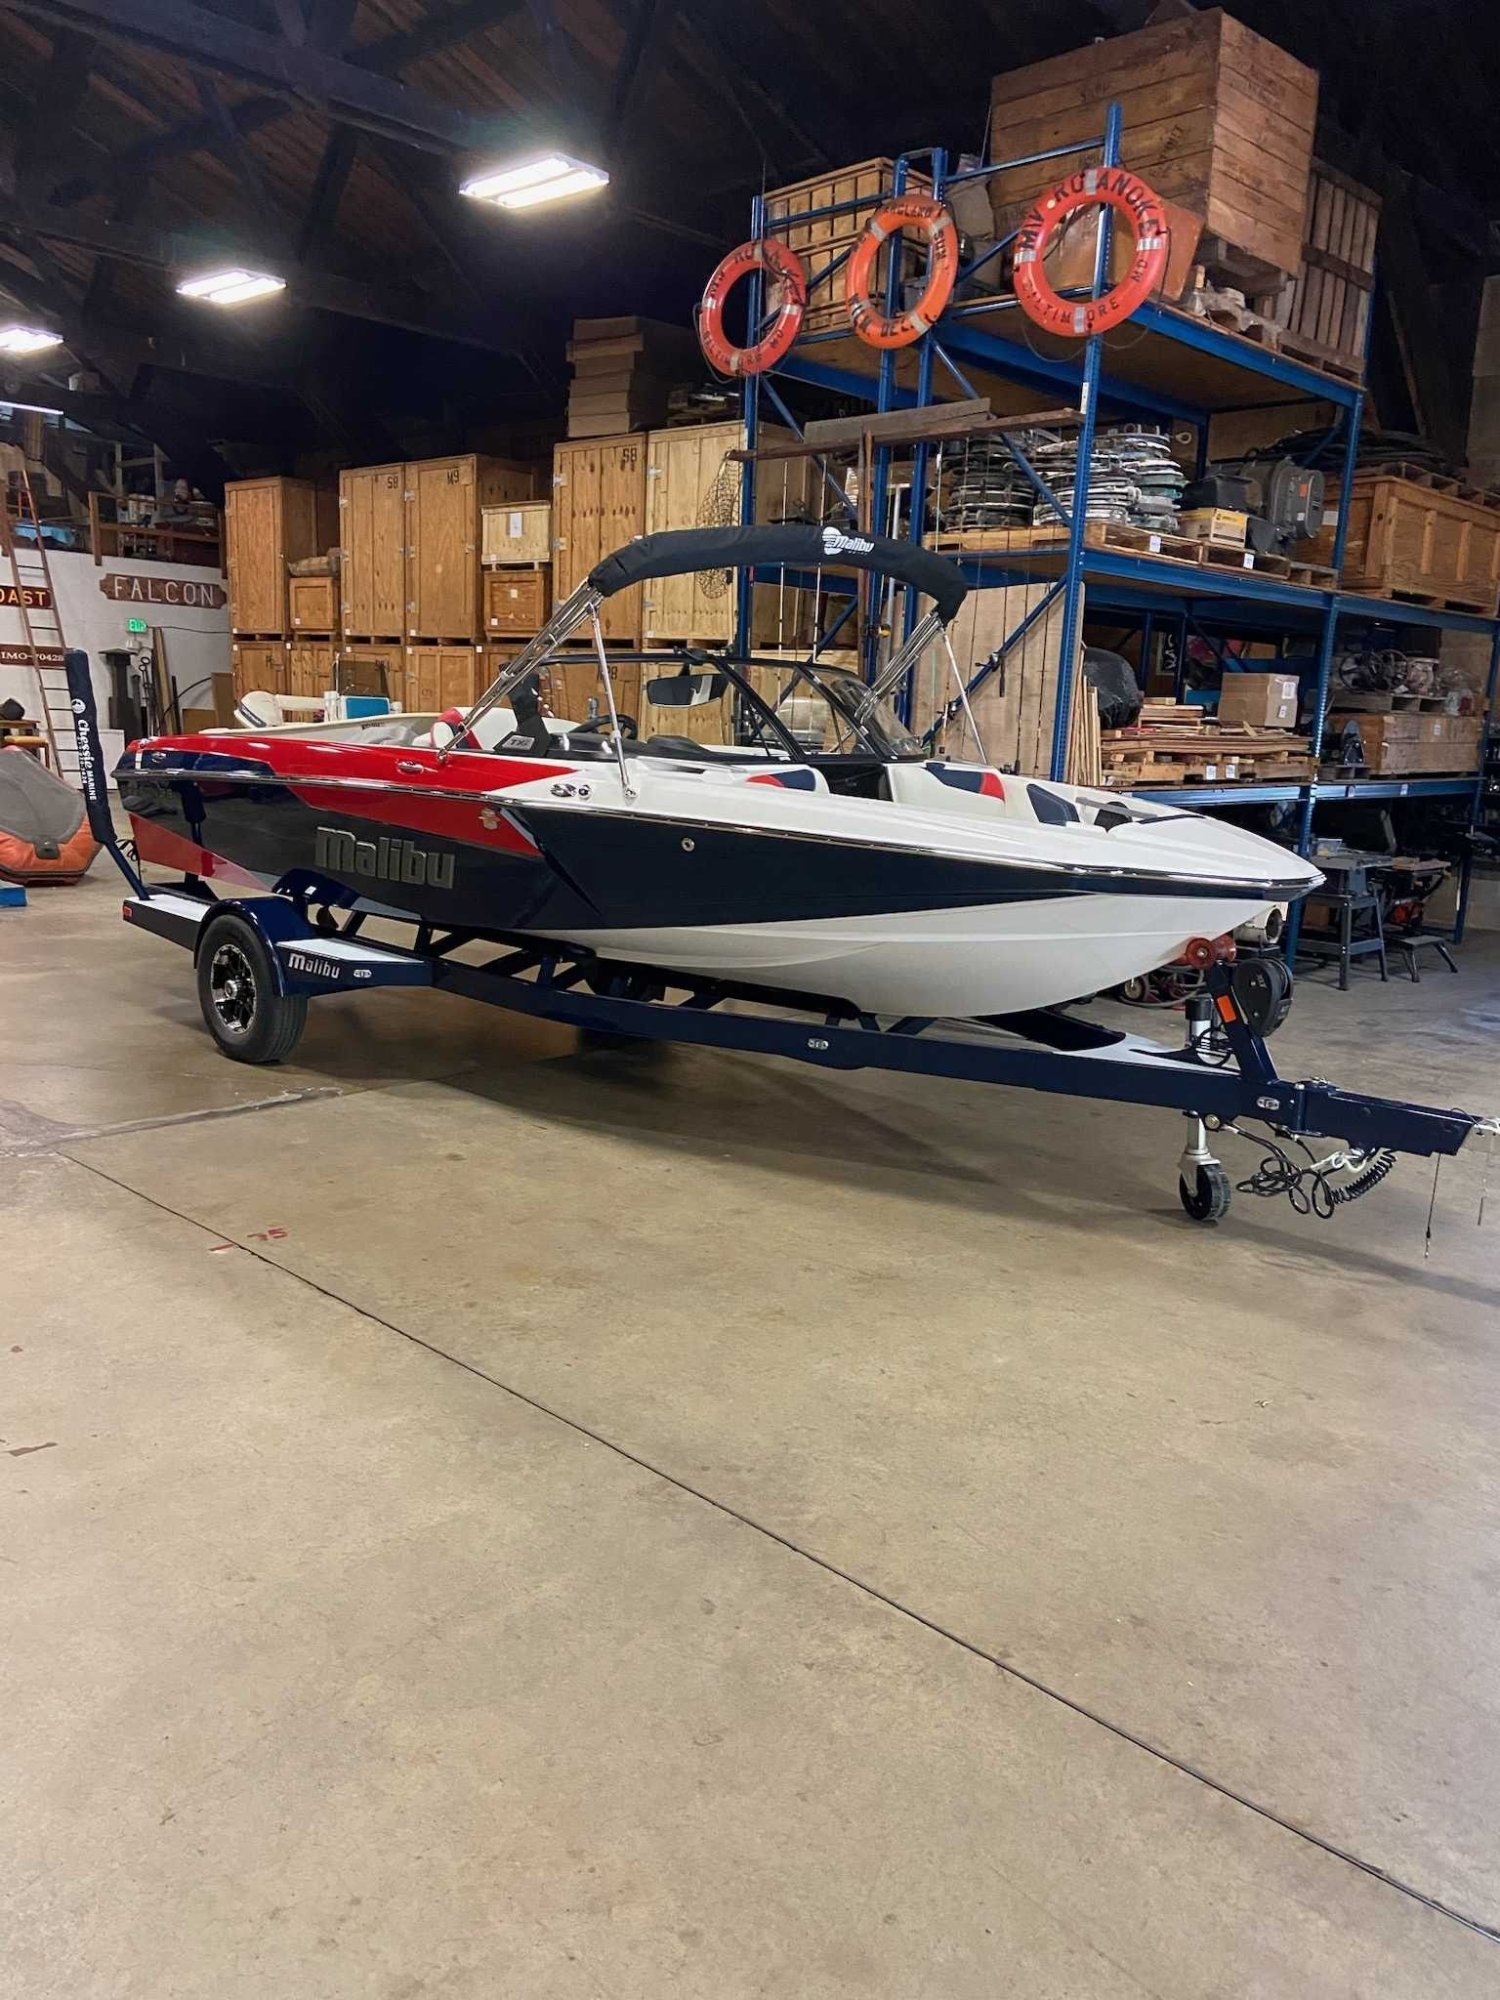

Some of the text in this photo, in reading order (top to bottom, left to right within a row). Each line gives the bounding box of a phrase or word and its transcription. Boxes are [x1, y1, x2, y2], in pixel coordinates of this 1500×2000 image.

[834, 535, 875, 553] Malibu
[113, 576, 214, 606] FALCON
[86, 770, 97, 801] MARINE
[315, 826, 455, 889] Malibu
[288, 953, 341, 979] Malibu
